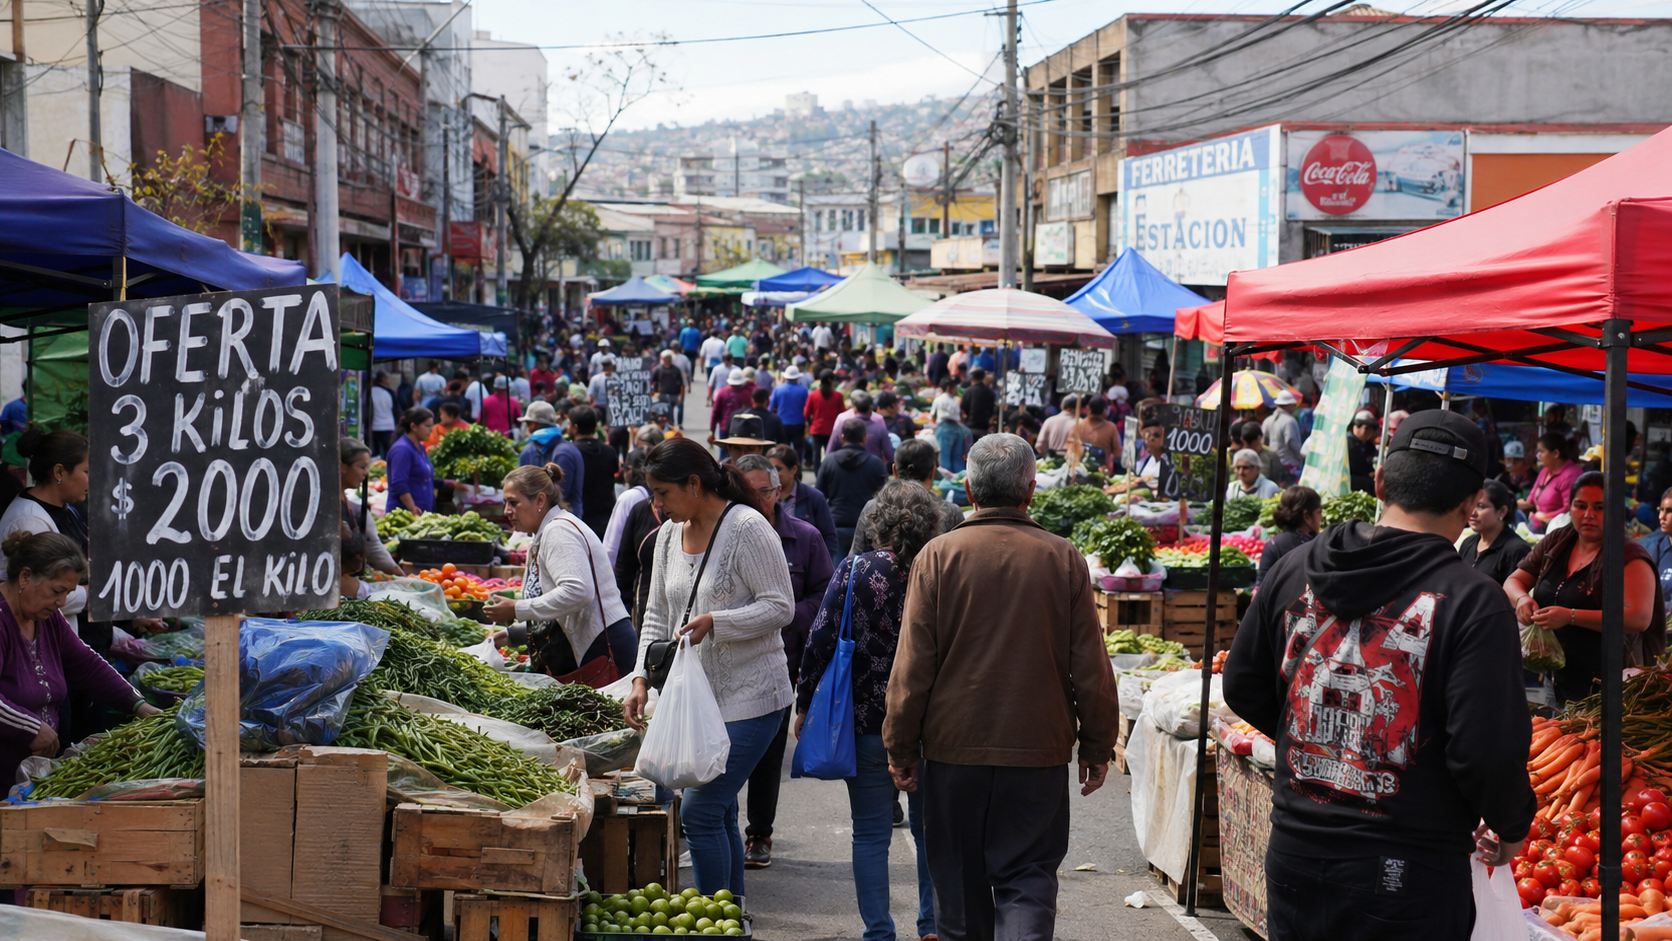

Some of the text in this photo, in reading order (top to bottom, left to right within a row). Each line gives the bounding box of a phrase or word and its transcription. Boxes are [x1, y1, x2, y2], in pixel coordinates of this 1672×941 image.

[1131, 137, 1255, 187] FERRETERIA
[1303, 161, 1372, 185] Coca-Cola
[99, 291, 337, 388] OFERTA
[110, 393, 148, 465] 3
[1167, 427, 1213, 455] 1000
[111, 456, 321, 545] $ 2000
[98, 557, 190, 614] 1000
[210, 554, 246, 599] EL
